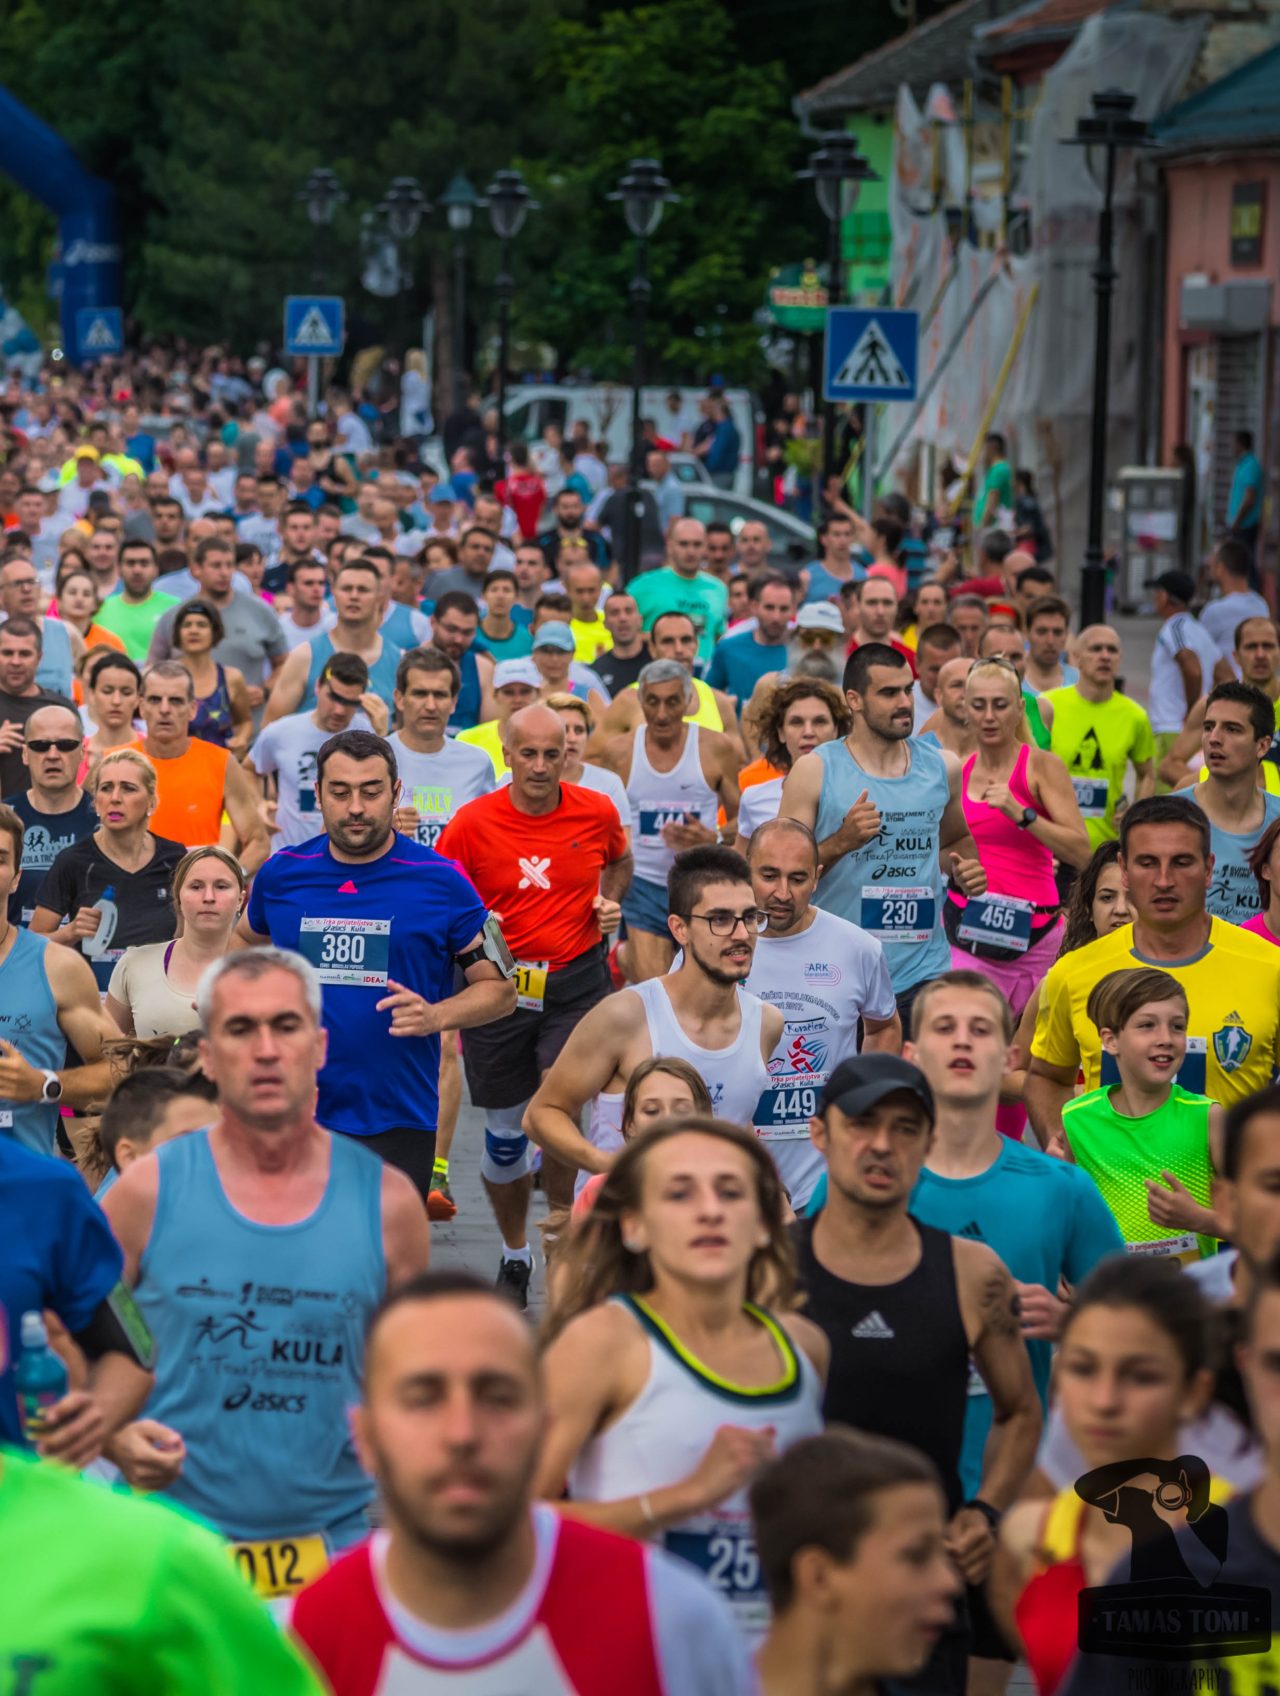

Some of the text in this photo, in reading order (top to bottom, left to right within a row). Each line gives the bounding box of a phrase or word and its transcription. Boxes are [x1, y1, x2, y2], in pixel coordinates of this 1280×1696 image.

[896, 837, 932, 851] KULA
[21, 856, 39, 864] KOLA
[888, 866, 917, 878] asics
[882, 901, 918, 924] 230
[981, 905, 1016, 931] 455
[322, 933, 365, 964] 380
[809, 963, 829, 972] ARK
[772, 1089, 816, 1118] 449
[251, 1392, 306, 1413] asics
